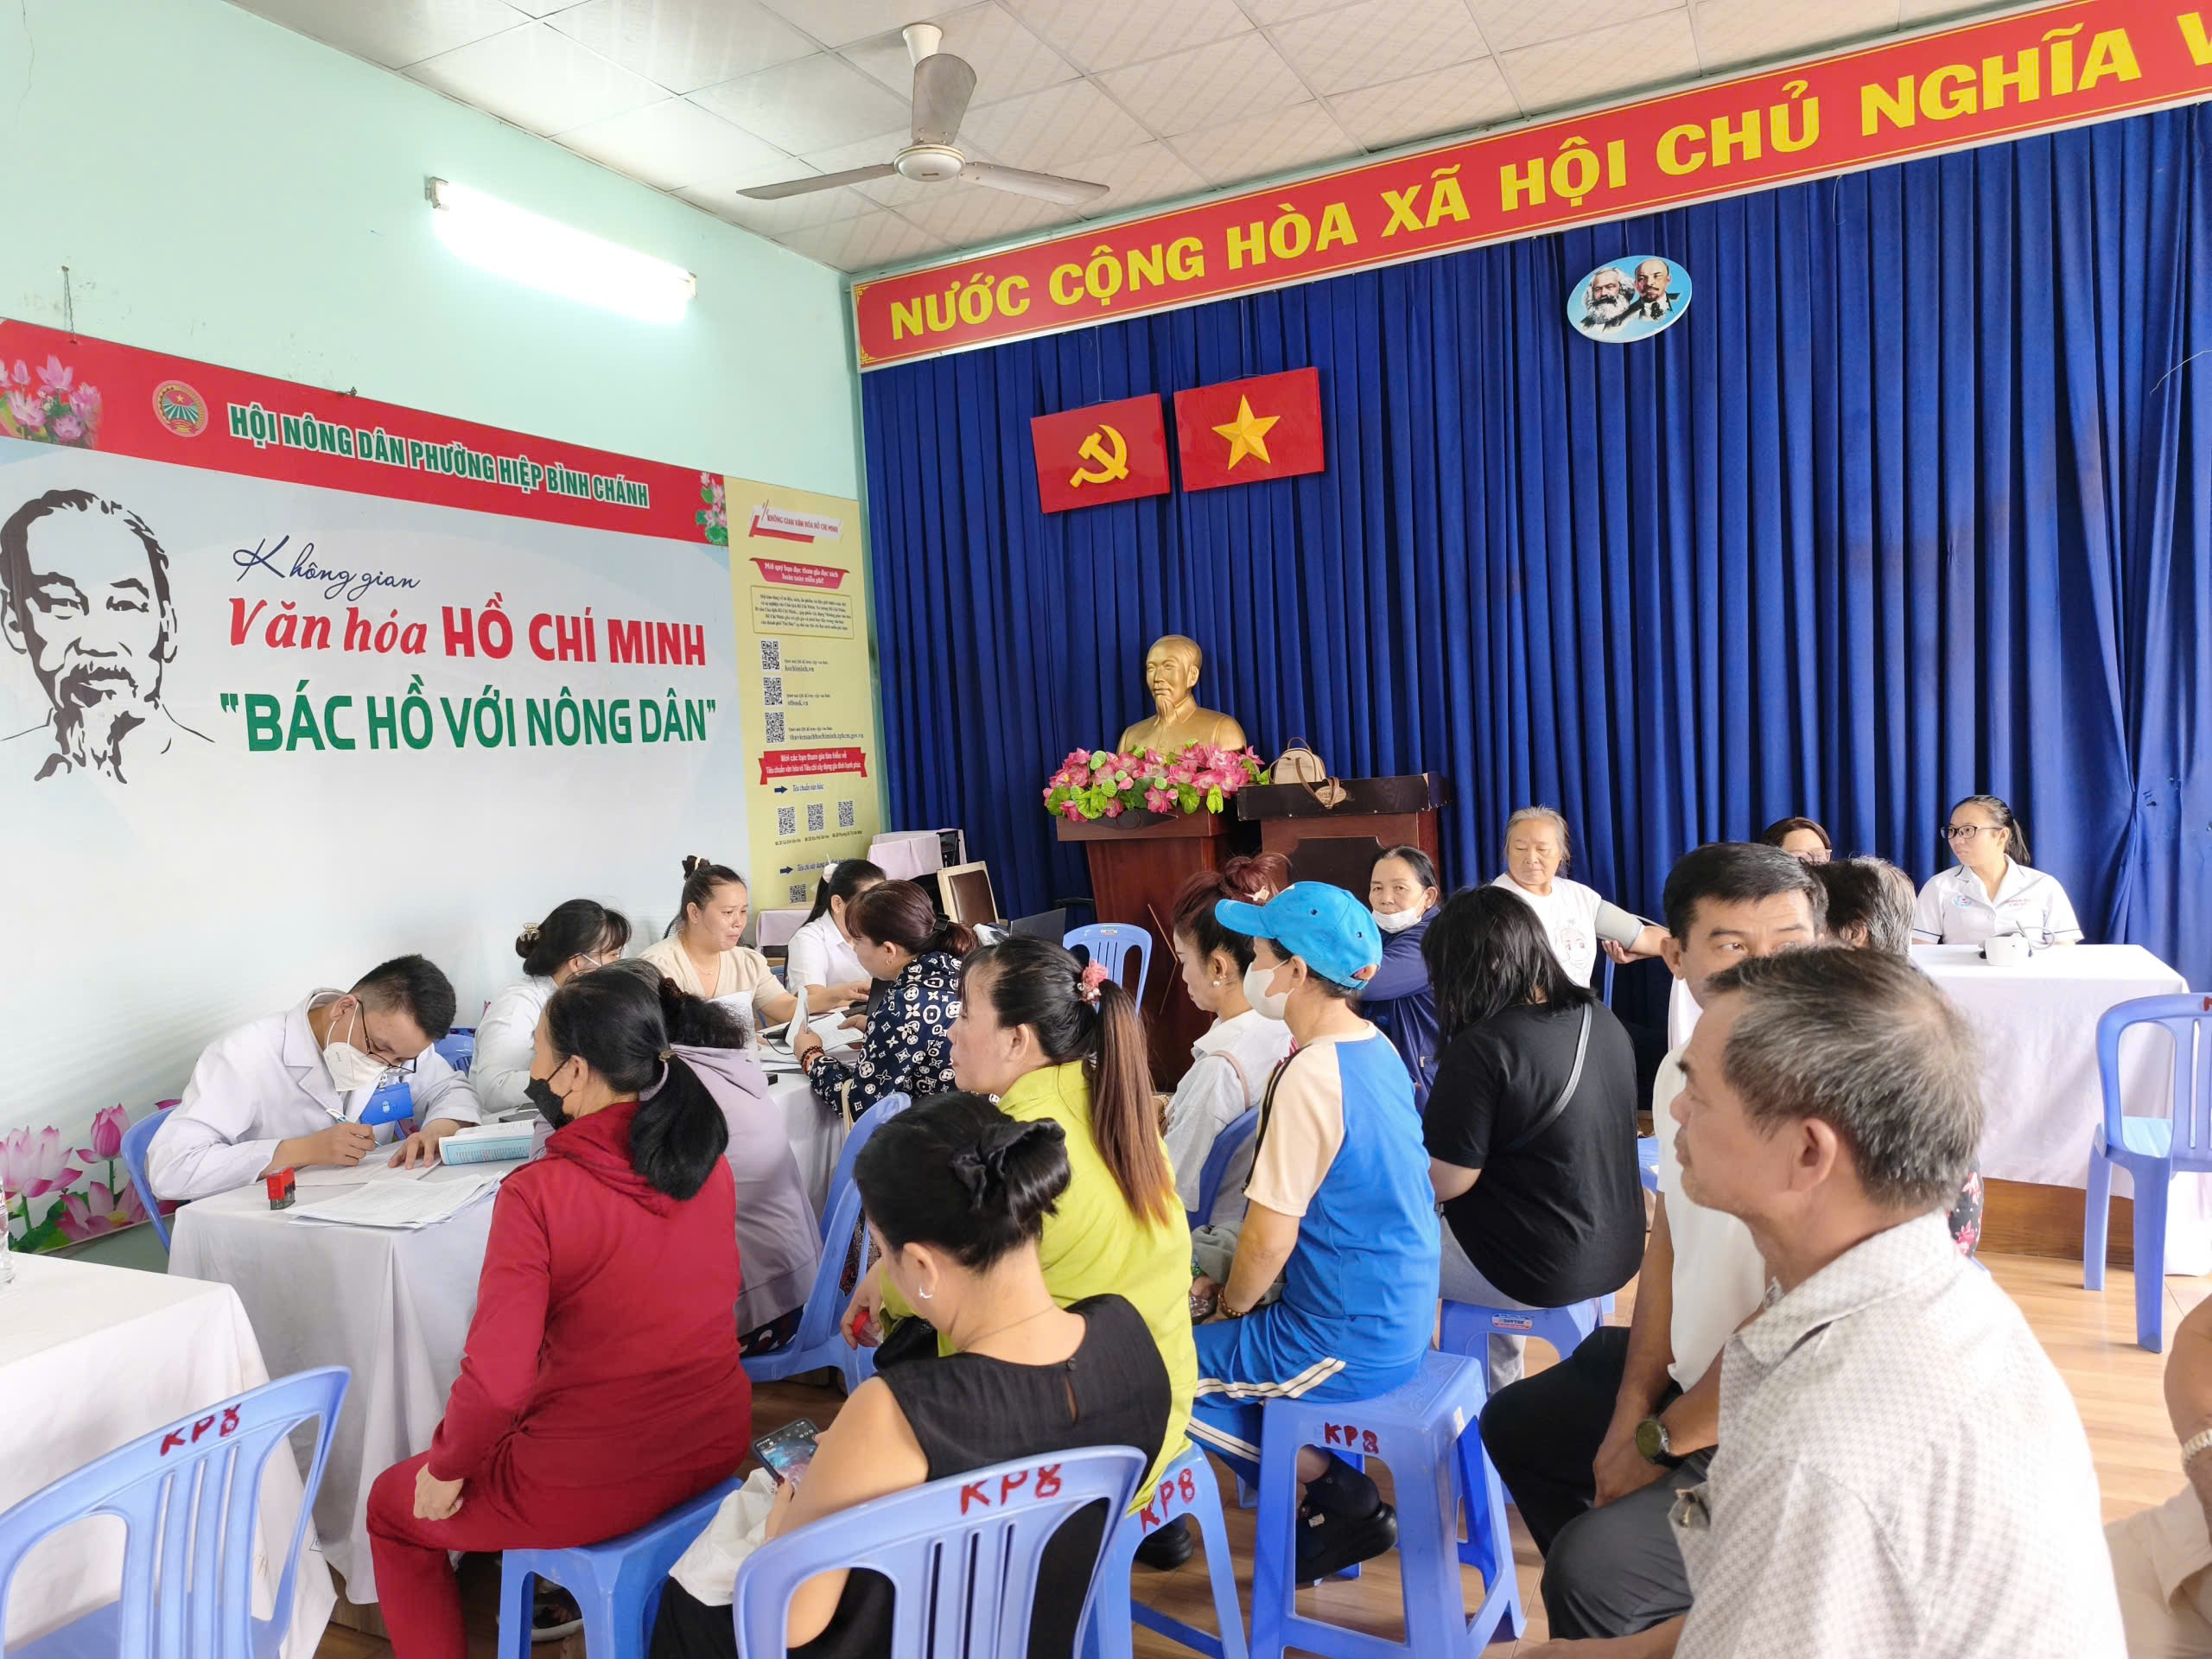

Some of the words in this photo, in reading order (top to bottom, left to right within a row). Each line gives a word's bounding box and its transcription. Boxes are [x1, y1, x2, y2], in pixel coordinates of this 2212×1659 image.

[890, 271, 1031, 340] NƯỚC
[1049, 245, 1205, 307] CỘNG
[1227, 201, 1358, 270] HÒA
[1381, 163, 1471, 238] XÃ
[1500, 136, 1627, 208] HỘI
[1656, 79, 1821, 176] CHỦ
[1860, 22, 2142, 137] NGHĨA
[228, 403, 278, 448] HỘI
[281, 413, 354, 458] NÔNG
[357, 428, 406, 467] DÂN
[409, 439, 496, 482] PHƯỜNG
[498, 455, 543, 493] HIỆP
[545, 462, 591, 499] BÌNH
[593, 474, 649, 508] CHÁNH
[233, 535, 357, 600] Không
[347, 571, 421, 601] gian
[229, 598, 331, 650] Văn
[343, 607, 428, 655] hóa
[442, 591, 513, 659] HỒ
[529, 607, 596, 664] CHÍ
[608, 618, 706, 666] MINH
[368, 674, 433, 750] HỒ
[441, 686, 516, 748] VỚI
[526, 686, 632, 747] NÔNG
[160, 1402, 242, 1457] KP8
[1324, 1421, 1379, 1454] KP8
[960, 1464, 1062, 1516] KP8
[1140, 1468, 1196, 1535] KP8
